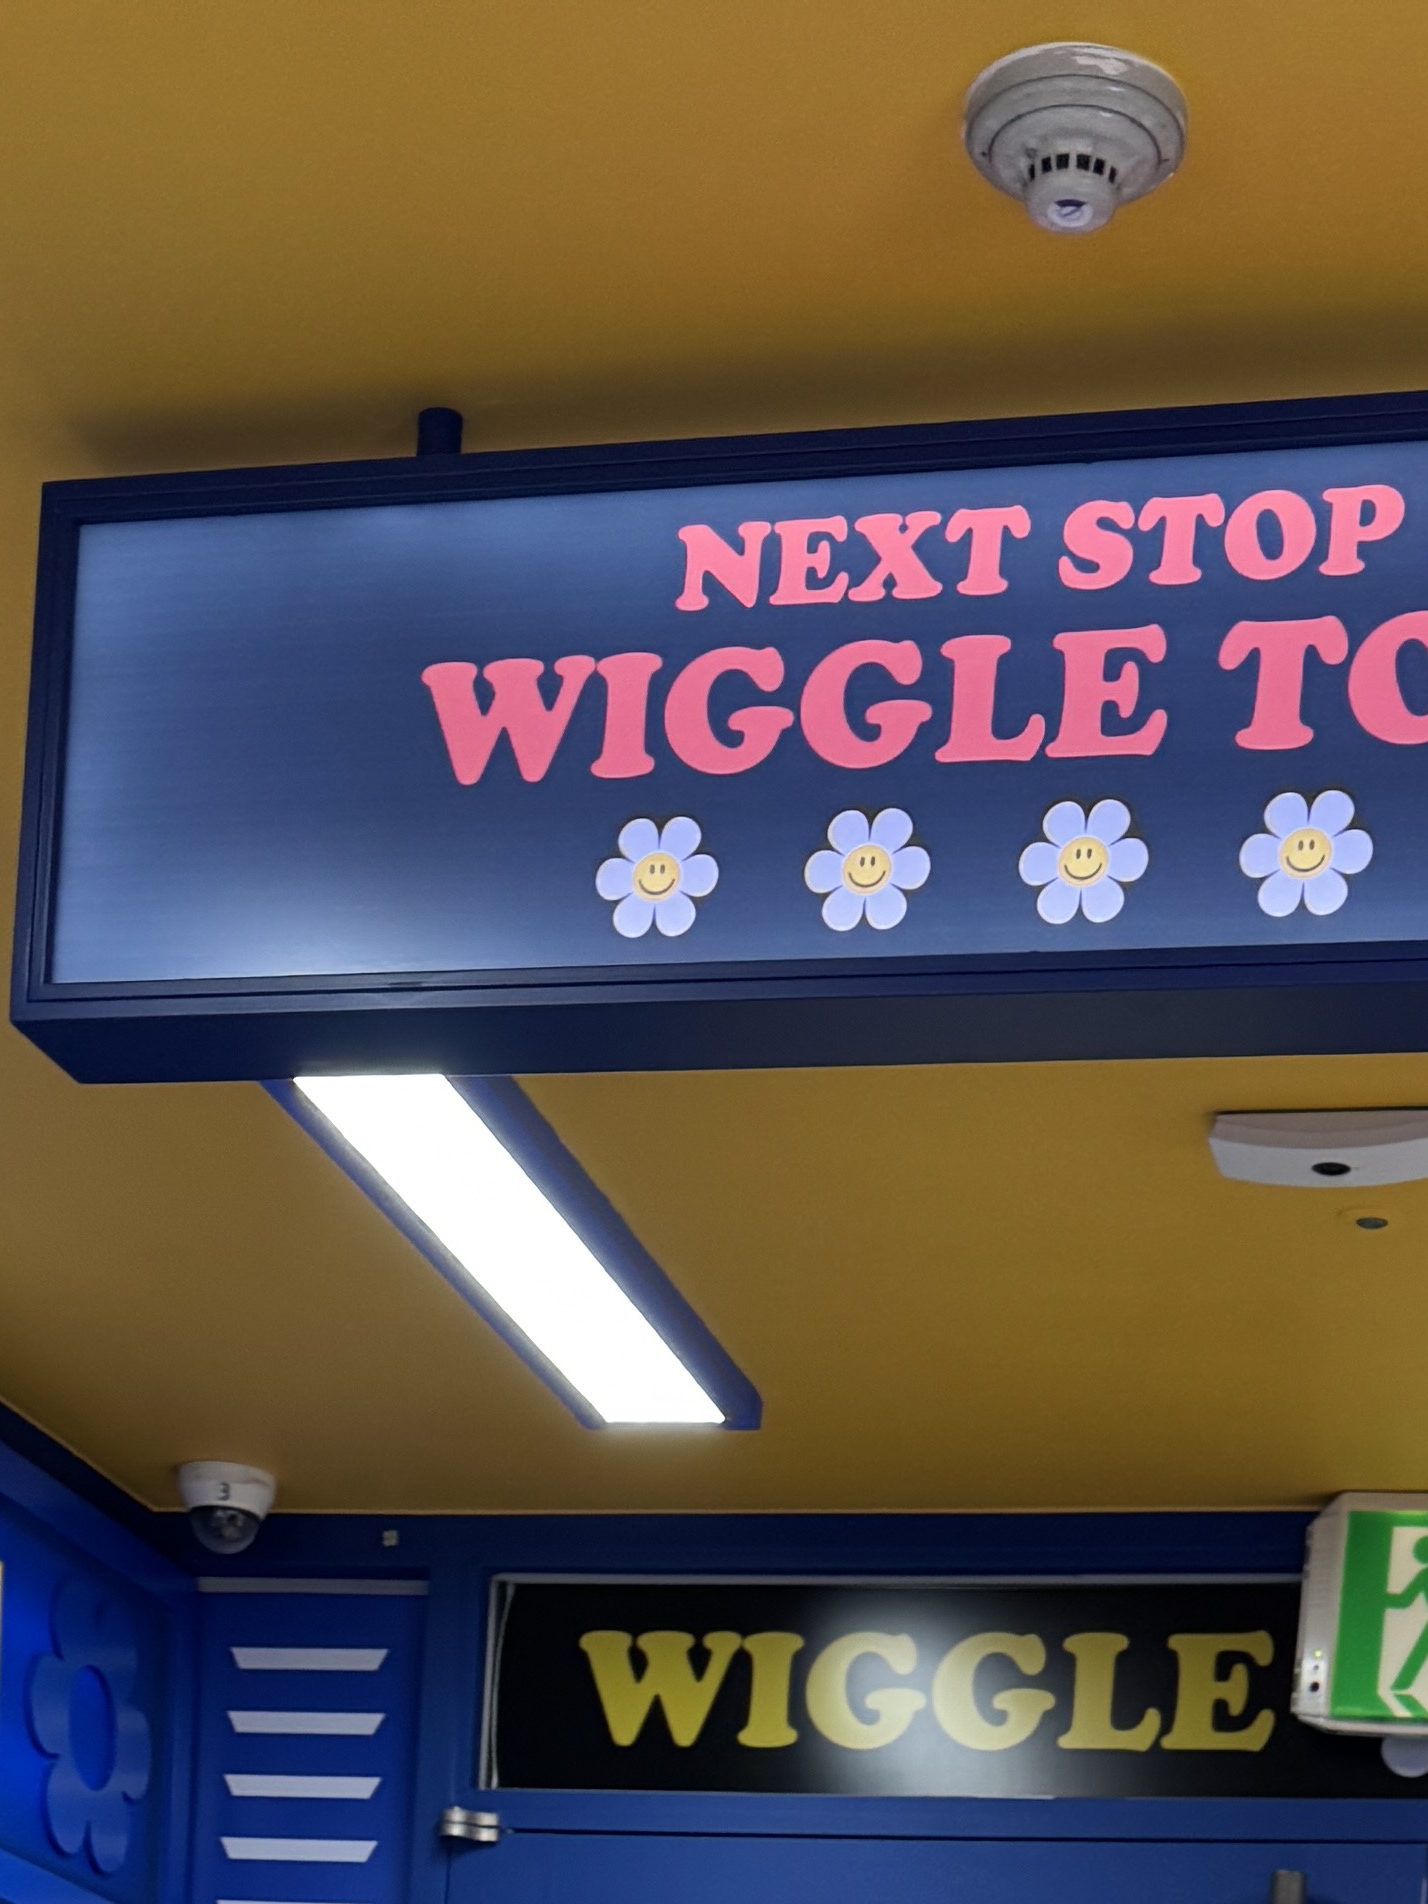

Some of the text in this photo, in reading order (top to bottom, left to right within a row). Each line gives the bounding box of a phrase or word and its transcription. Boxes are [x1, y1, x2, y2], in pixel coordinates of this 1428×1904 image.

[675, 507, 1030, 611] NEXT
[1058, 484, 1404, 591] STOP
[422, 623, 1169, 786] WIGGLE
[580, 1630, 1275, 1752] WIGGLE
